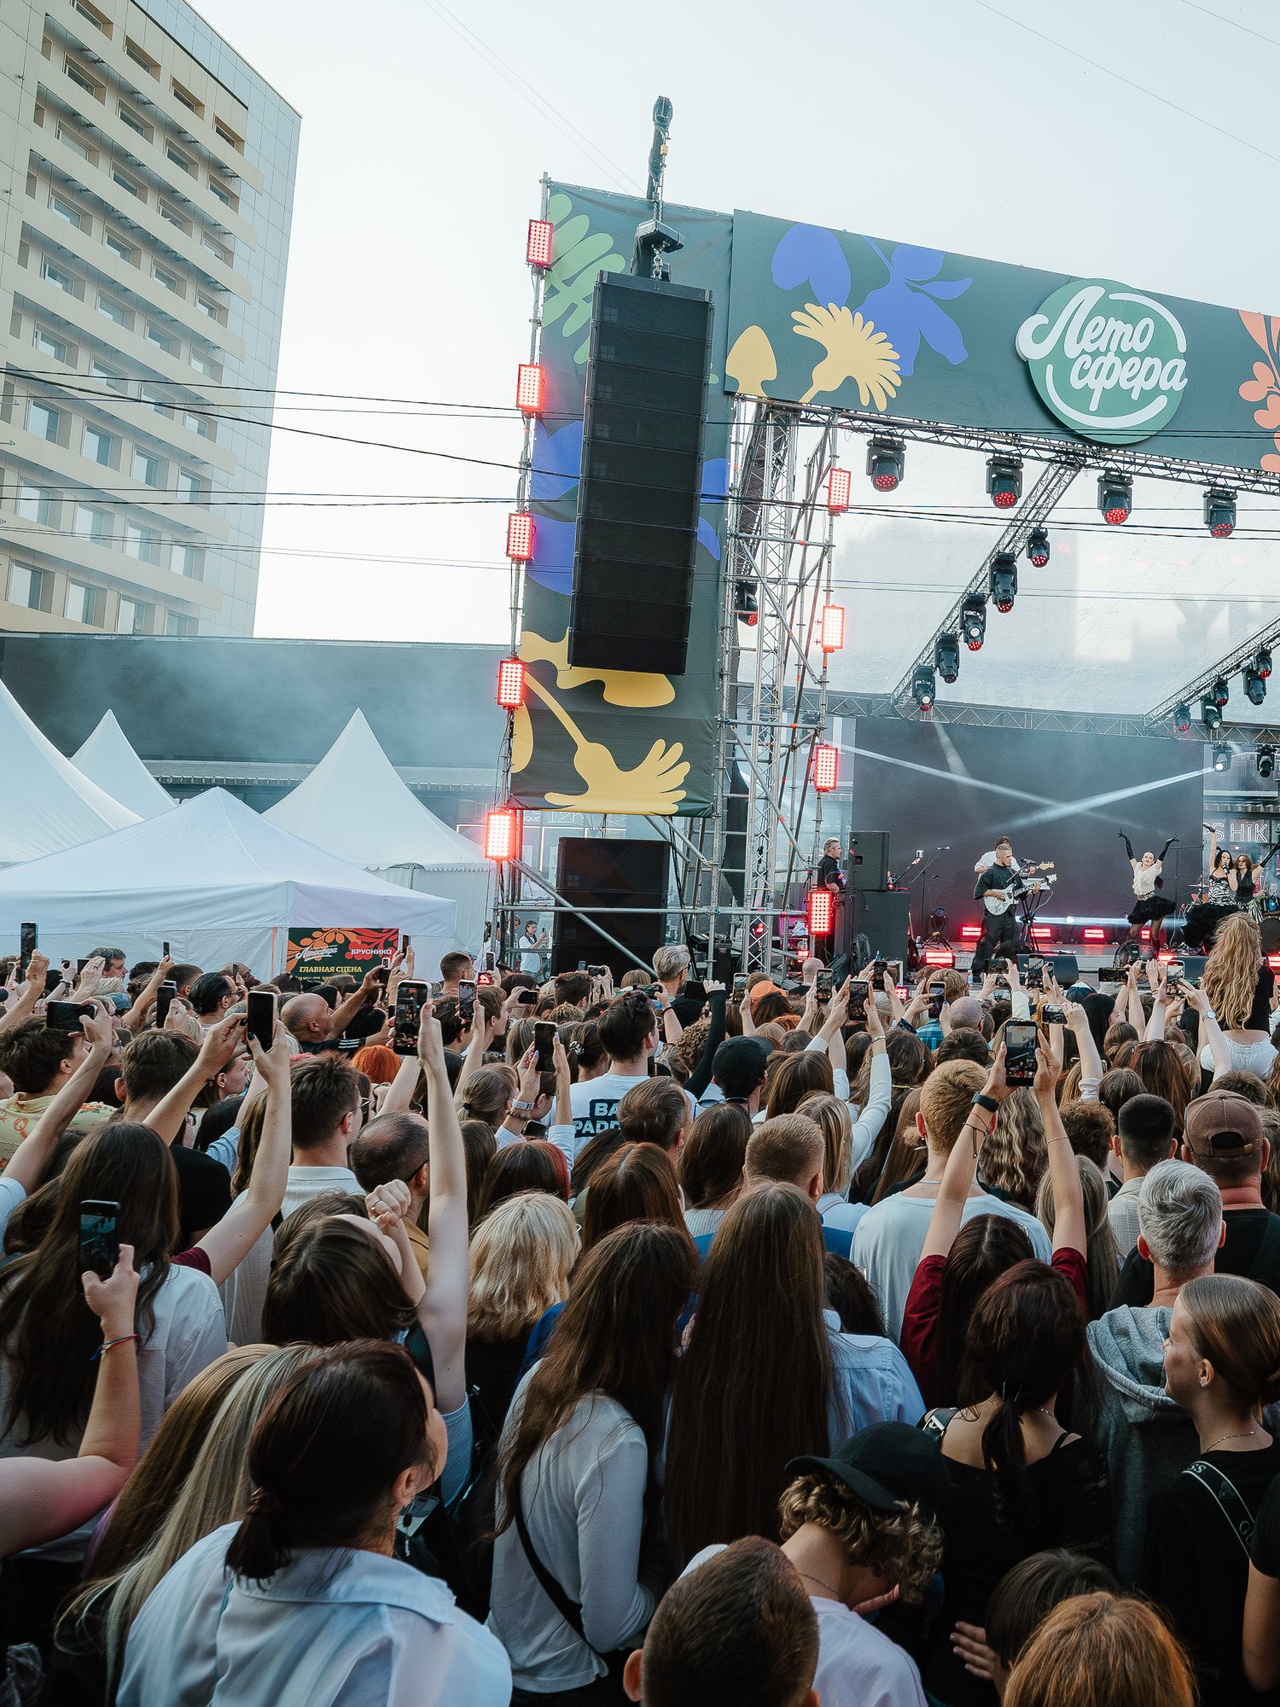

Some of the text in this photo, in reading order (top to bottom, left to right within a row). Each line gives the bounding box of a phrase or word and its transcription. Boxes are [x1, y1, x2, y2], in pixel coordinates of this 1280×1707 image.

[1017, 285, 1155, 360] Лето
[1069, 351, 1189, 412] сфера
[335, 966, 363, 974] СЦЕНА
[594, 1102, 618, 1117] BA
